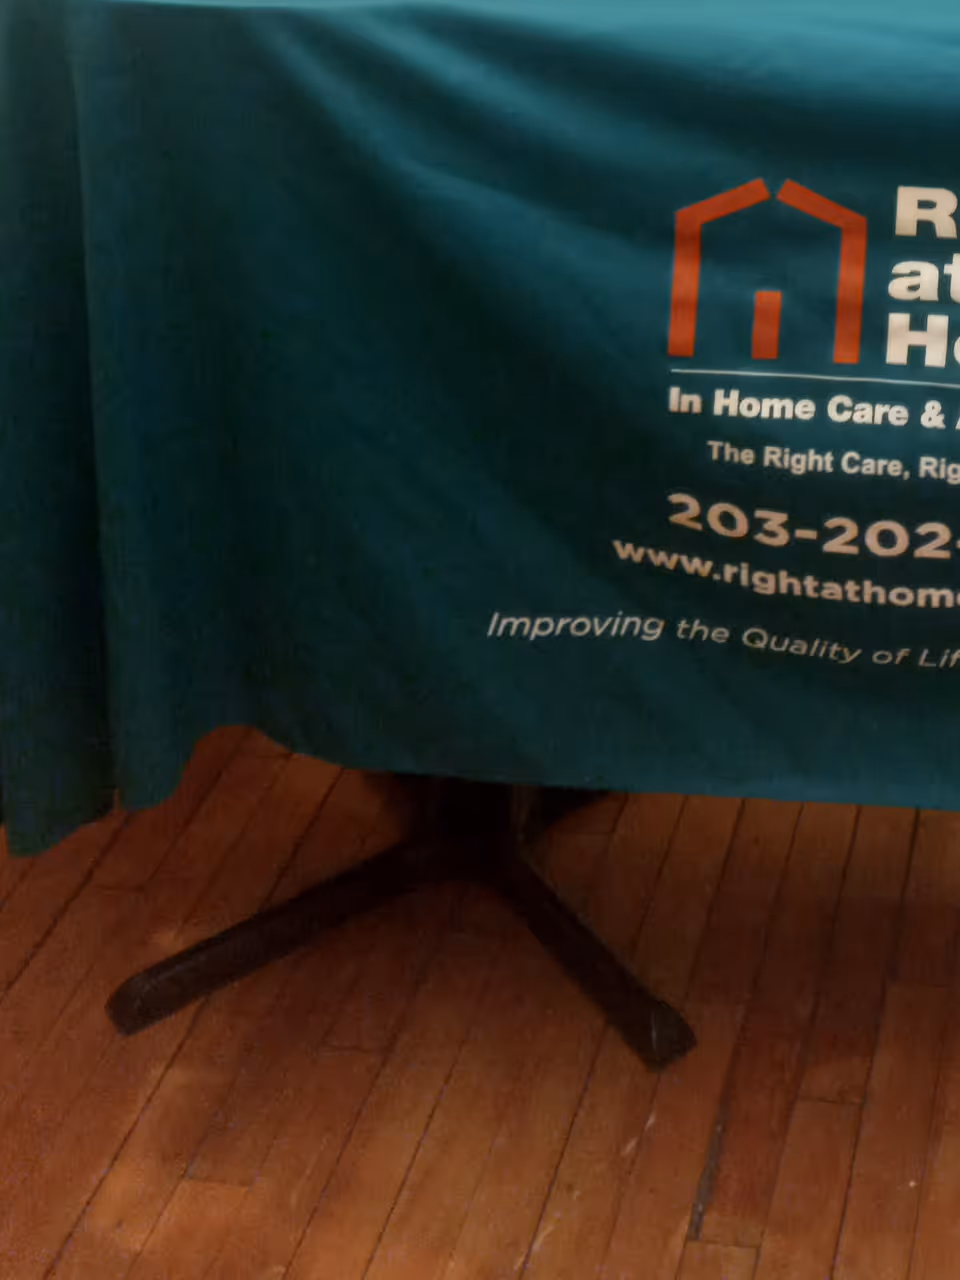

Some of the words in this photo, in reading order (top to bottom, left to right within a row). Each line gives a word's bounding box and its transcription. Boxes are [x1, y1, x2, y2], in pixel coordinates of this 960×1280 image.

[668, 386, 702, 415] In
[713, 388, 817, 422] Home
[826, 394, 910, 428] Care
[920, 400, 946, 430] &
[707, 440, 755, 466] The
[763, 444, 834, 477] Right
[840, 450, 911, 480] Care,
[488, 612, 666, 643] Improving
[677, 617, 730, 644] the
[741, 627, 862, 665] Quality
[872, 649, 910, 666] of
